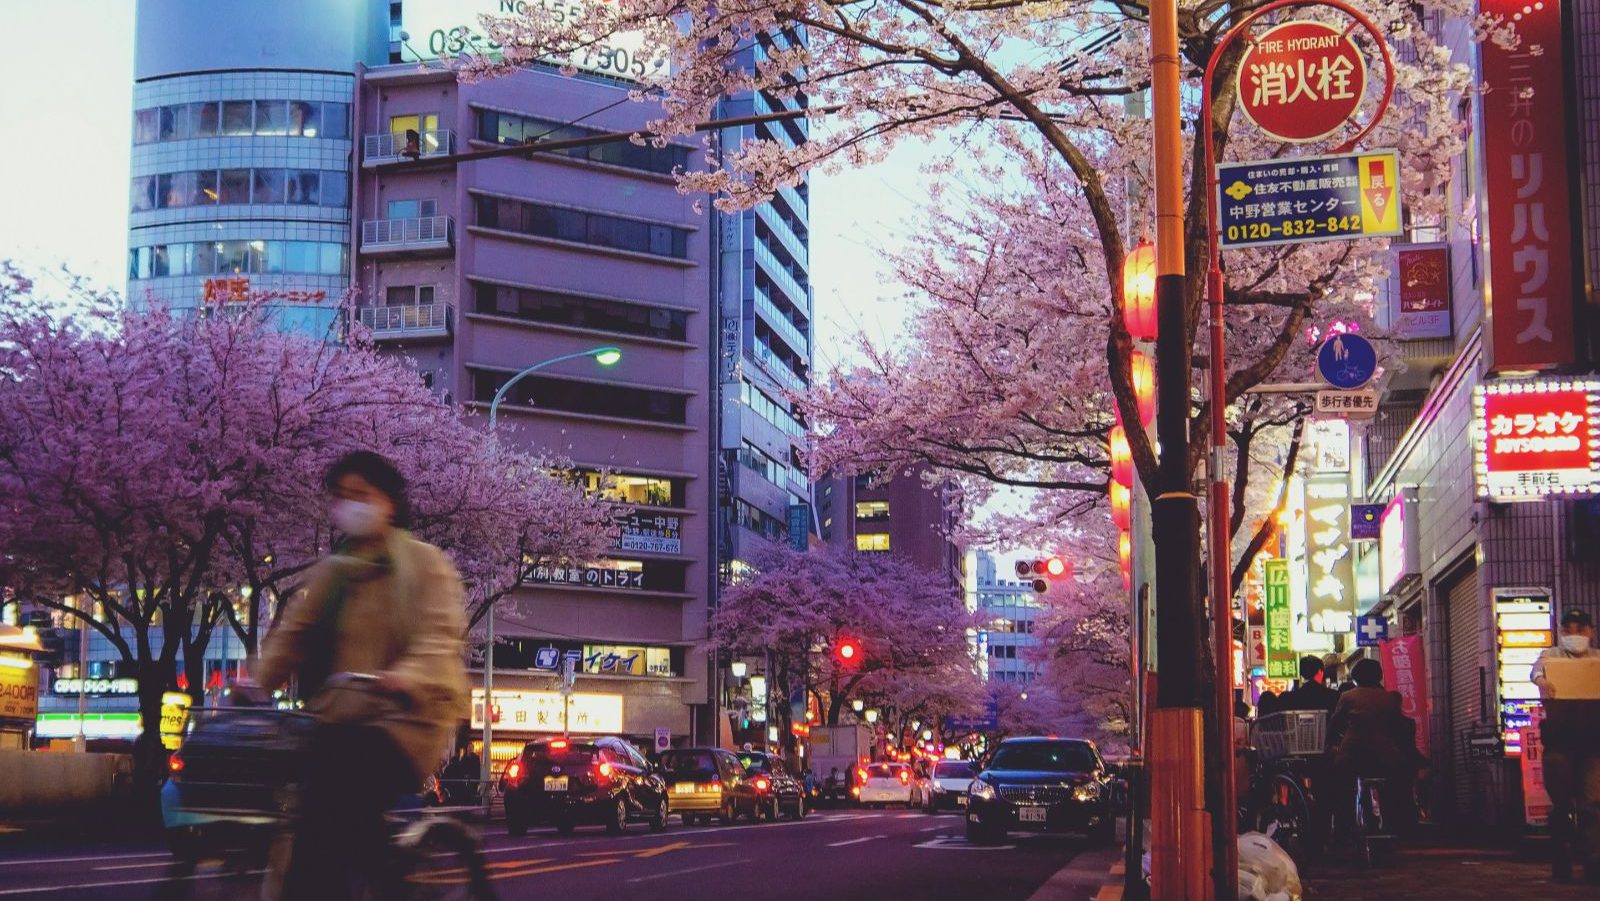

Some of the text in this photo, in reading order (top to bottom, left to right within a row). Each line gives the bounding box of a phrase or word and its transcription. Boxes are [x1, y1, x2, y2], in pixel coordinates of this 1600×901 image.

[1258, 35, 1341, 55] FIRE HYDRANT
[1250, 54, 1355, 107] 消火栓
[1229, 197, 1357, 220] 中野営業センター
[1509, 53, 1553, 344] 三井のリハウス
[1227, 215, 1361, 241] 0120-832-842
[1321, 393, 1374, 409] 歩行者優先
[1490, 411, 1584, 436] カラオケ
[1269, 563, 1290, 651] 広川歯科
